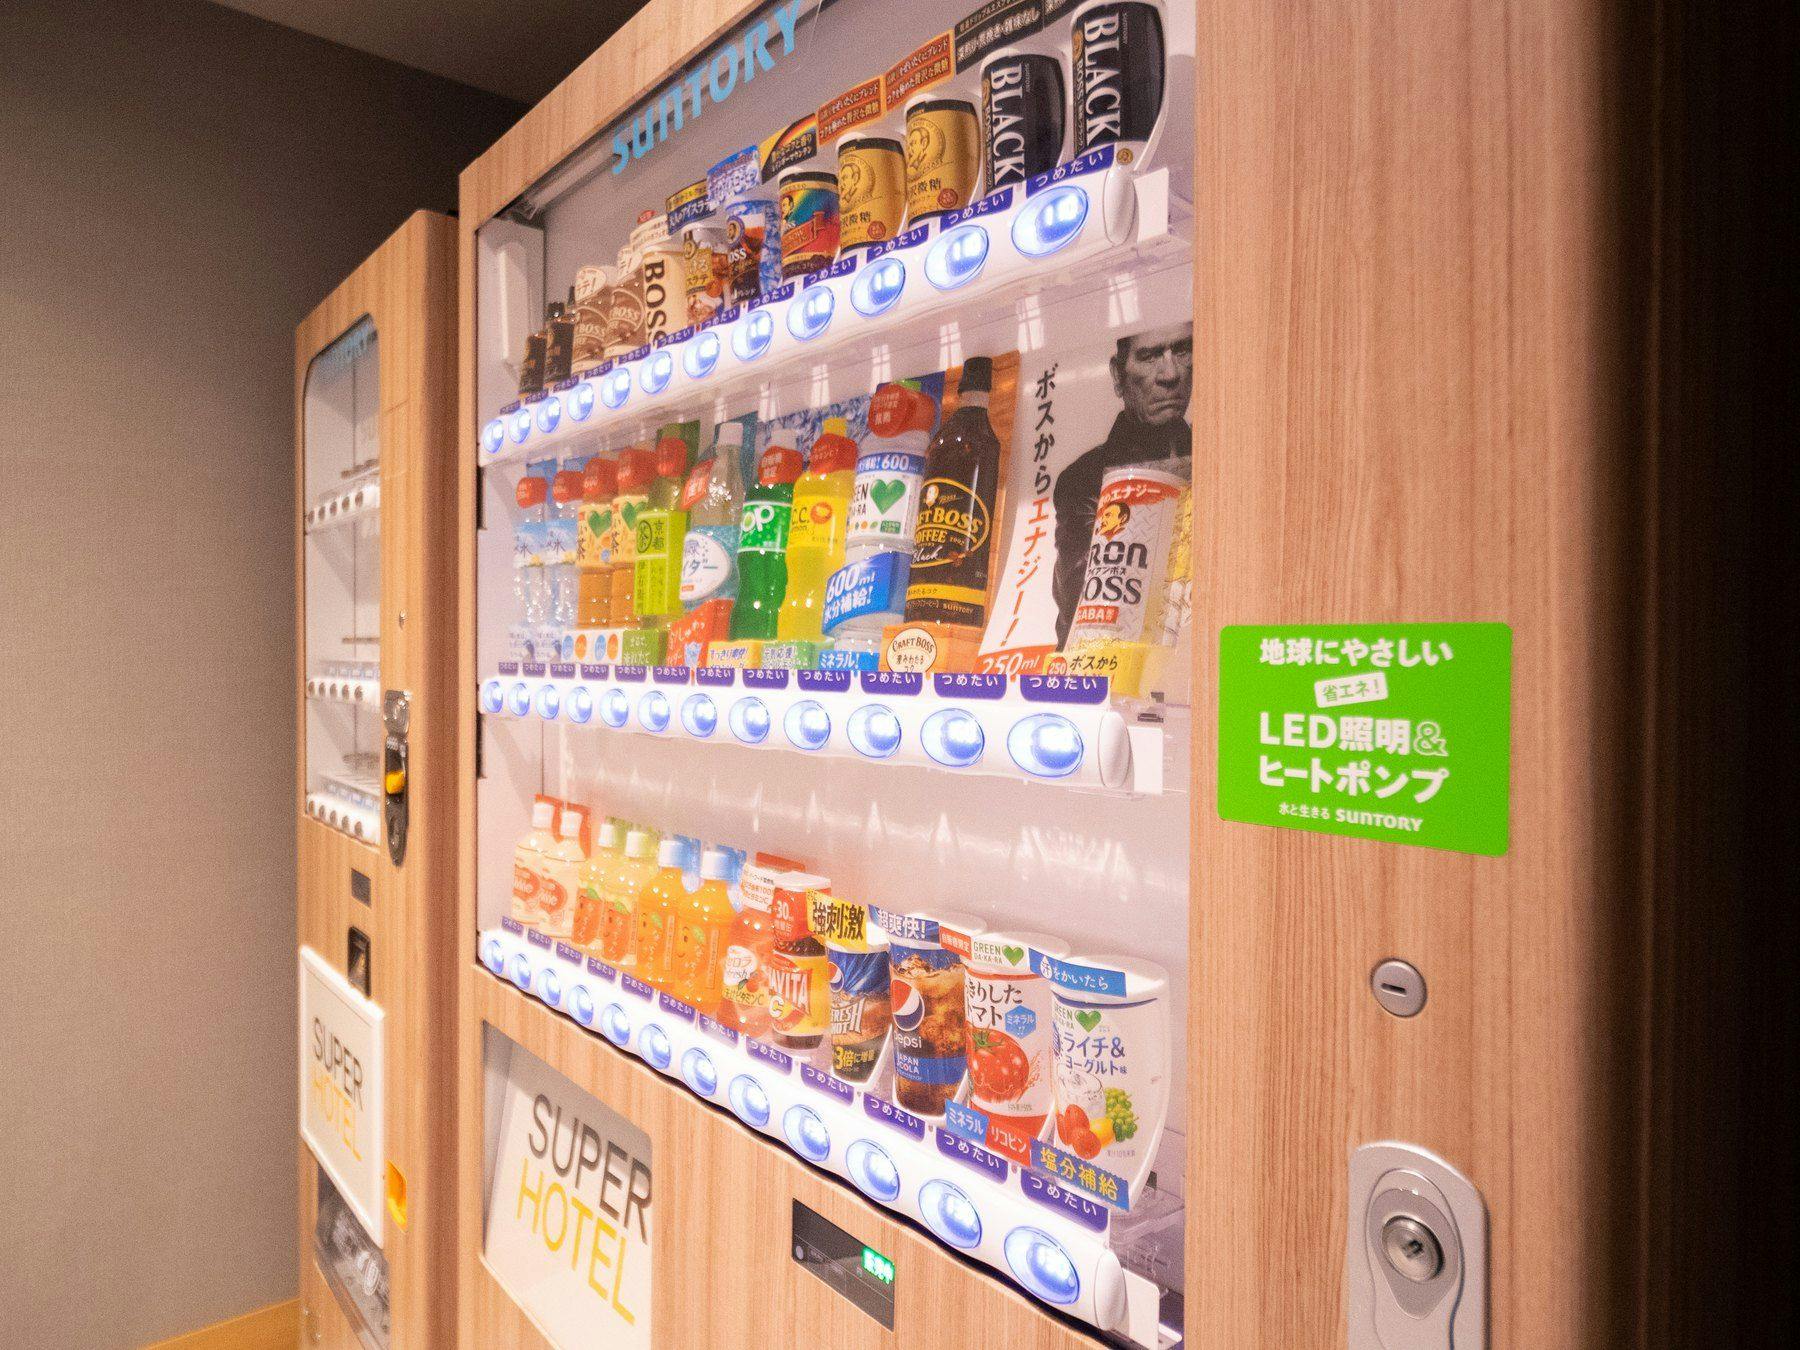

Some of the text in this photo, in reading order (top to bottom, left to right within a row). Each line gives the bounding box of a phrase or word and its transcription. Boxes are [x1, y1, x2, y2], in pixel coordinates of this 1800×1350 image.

[612, 0, 800, 175] SUNTORY
[1084, 13, 1121, 146] BLACK
[990, 63, 1026, 186] BLACK
[1034, 151, 1104, 187] つめたい
[947, 194, 1005, 223] つめたい
[873, 229, 922, 254] つめたい
[807, 261, 852, 285] つめたい
[752, 286, 791, 308] つめたい
[881, 454, 910, 471] 600
[933, 507, 983, 534] BOSS
[892, 637, 935, 654] CRAFT BOSS
[1259, 637, 1455, 668] 地球にやさしい
[656, 668, 686, 677] つめたい
[701, 668, 732, 678] つめたい
[747, 669, 785, 680] つめたい
[821, 652, 860, 669] ミネラル!
[1070, 655, 1118, 672] ボスから
[803, 672, 846, 684] つめたい
[867, 673, 916, 684] つめたい
[941, 674, 999, 687] つめたい
[1029, 676, 1098, 690] つめたい
[1321, 679, 1381, 703] 省エネ!
[1259, 755, 1450, 804] ヒートポンプ
[1278, 802, 1424, 832] 水と生きる SUNTORY
[812, 901, 865, 941] 強刺激
[877, 908, 927, 940] 超爽快!
[973, 941, 1001, 955] GREEN
[1041, 960, 1109, 991] 汗をかいたら
[662, 994, 692, 1016] つめたい
[703, 1017, 736, 1039] つめたい
[749, 1040, 788, 1066] つめたい
[1063, 1031, 1126, 1059] ライチ&
[312, 1016, 364, 1113] SUPER
[806, 1067, 849, 1094] つめたい
[312, 1068, 363, 1162] HOTEL
[869, 1097, 919, 1129] つめたい
[949, 1107, 984, 1136] ミネラル
[943, 1133, 1001, 1170] つめたい
[991, 1126, 1027, 1154] リコピン
[528, 1093, 654, 1246] SUPER
[1040, 1146, 1119, 1202] 塩分補給
[1030, 1175, 1098, 1217] つめたい
[516, 1157, 636, 1327] HOTEL
